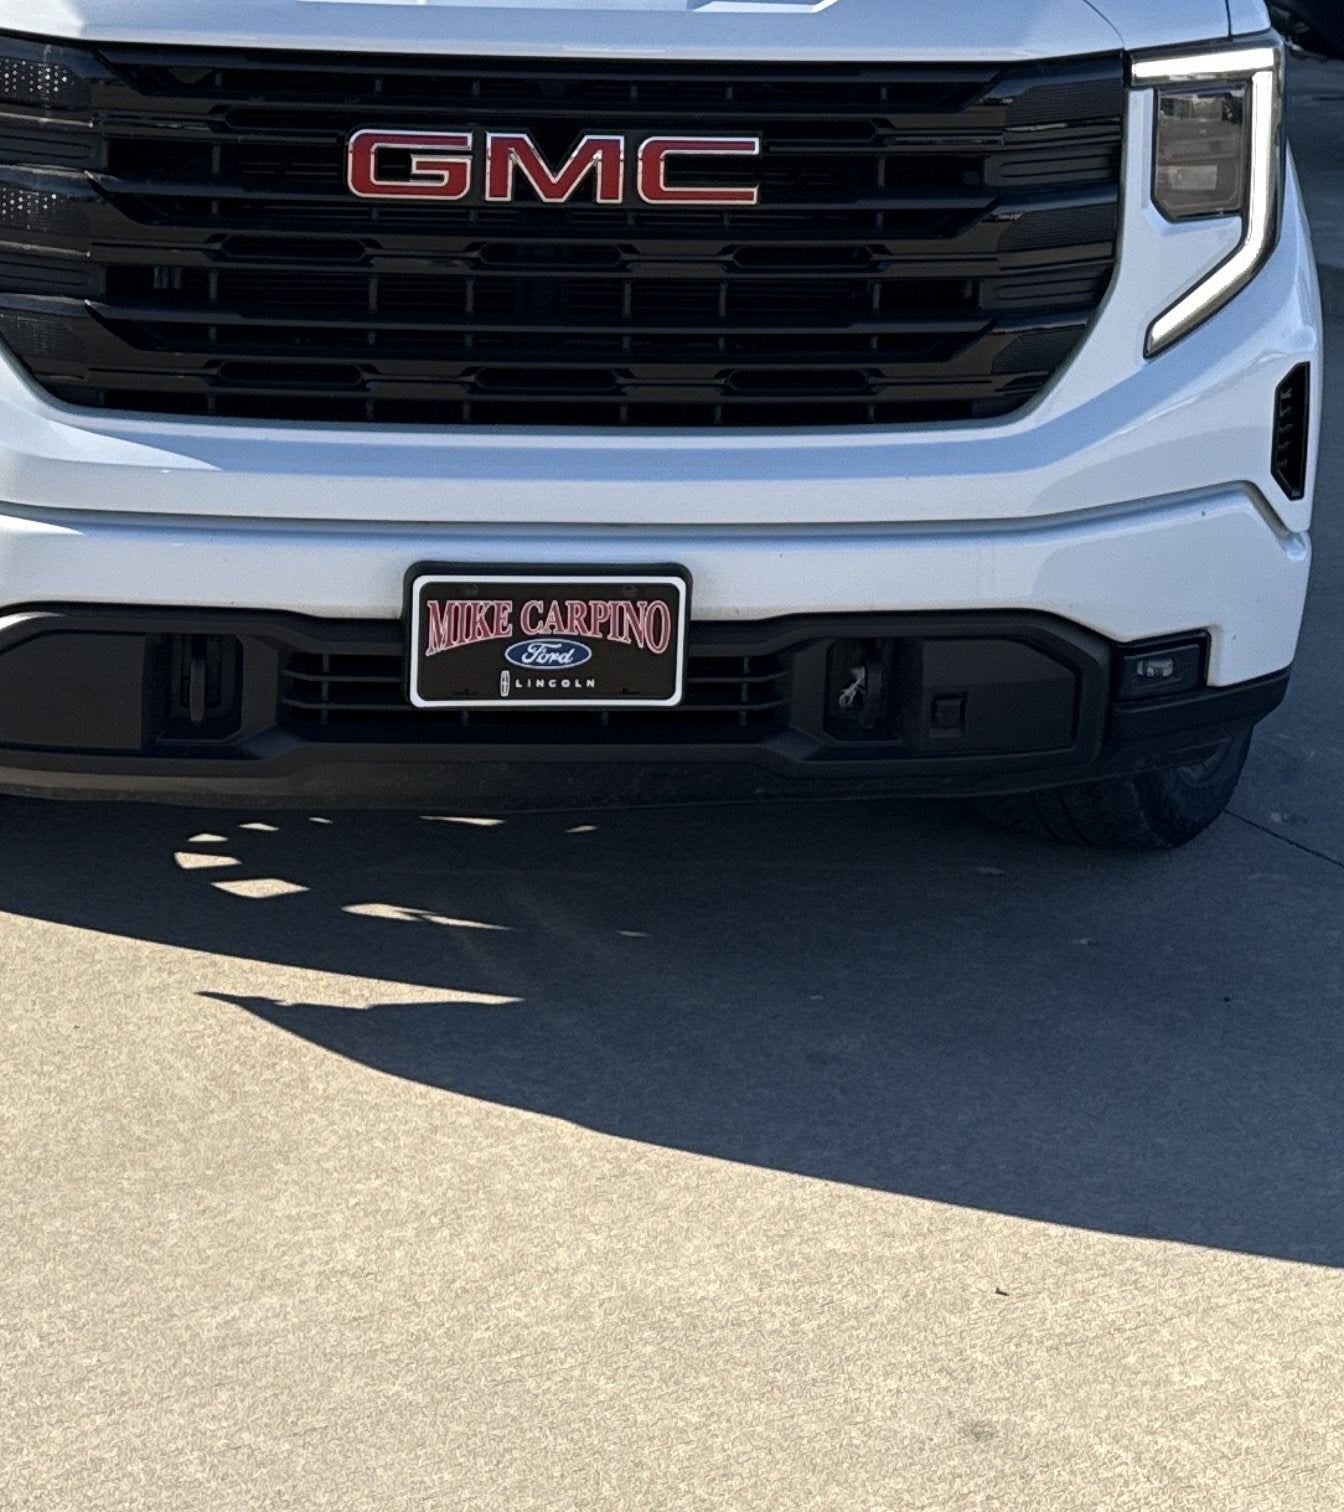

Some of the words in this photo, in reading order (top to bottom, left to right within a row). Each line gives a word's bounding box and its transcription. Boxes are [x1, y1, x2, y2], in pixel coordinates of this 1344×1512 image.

[347, 128, 760, 205] GMC
[425, 599, 513, 656] MIKE
[520, 599, 672, 654] CARPINO
[521, 643, 574, 664] Ford
[515, 678, 596, 688] LINCOLN
